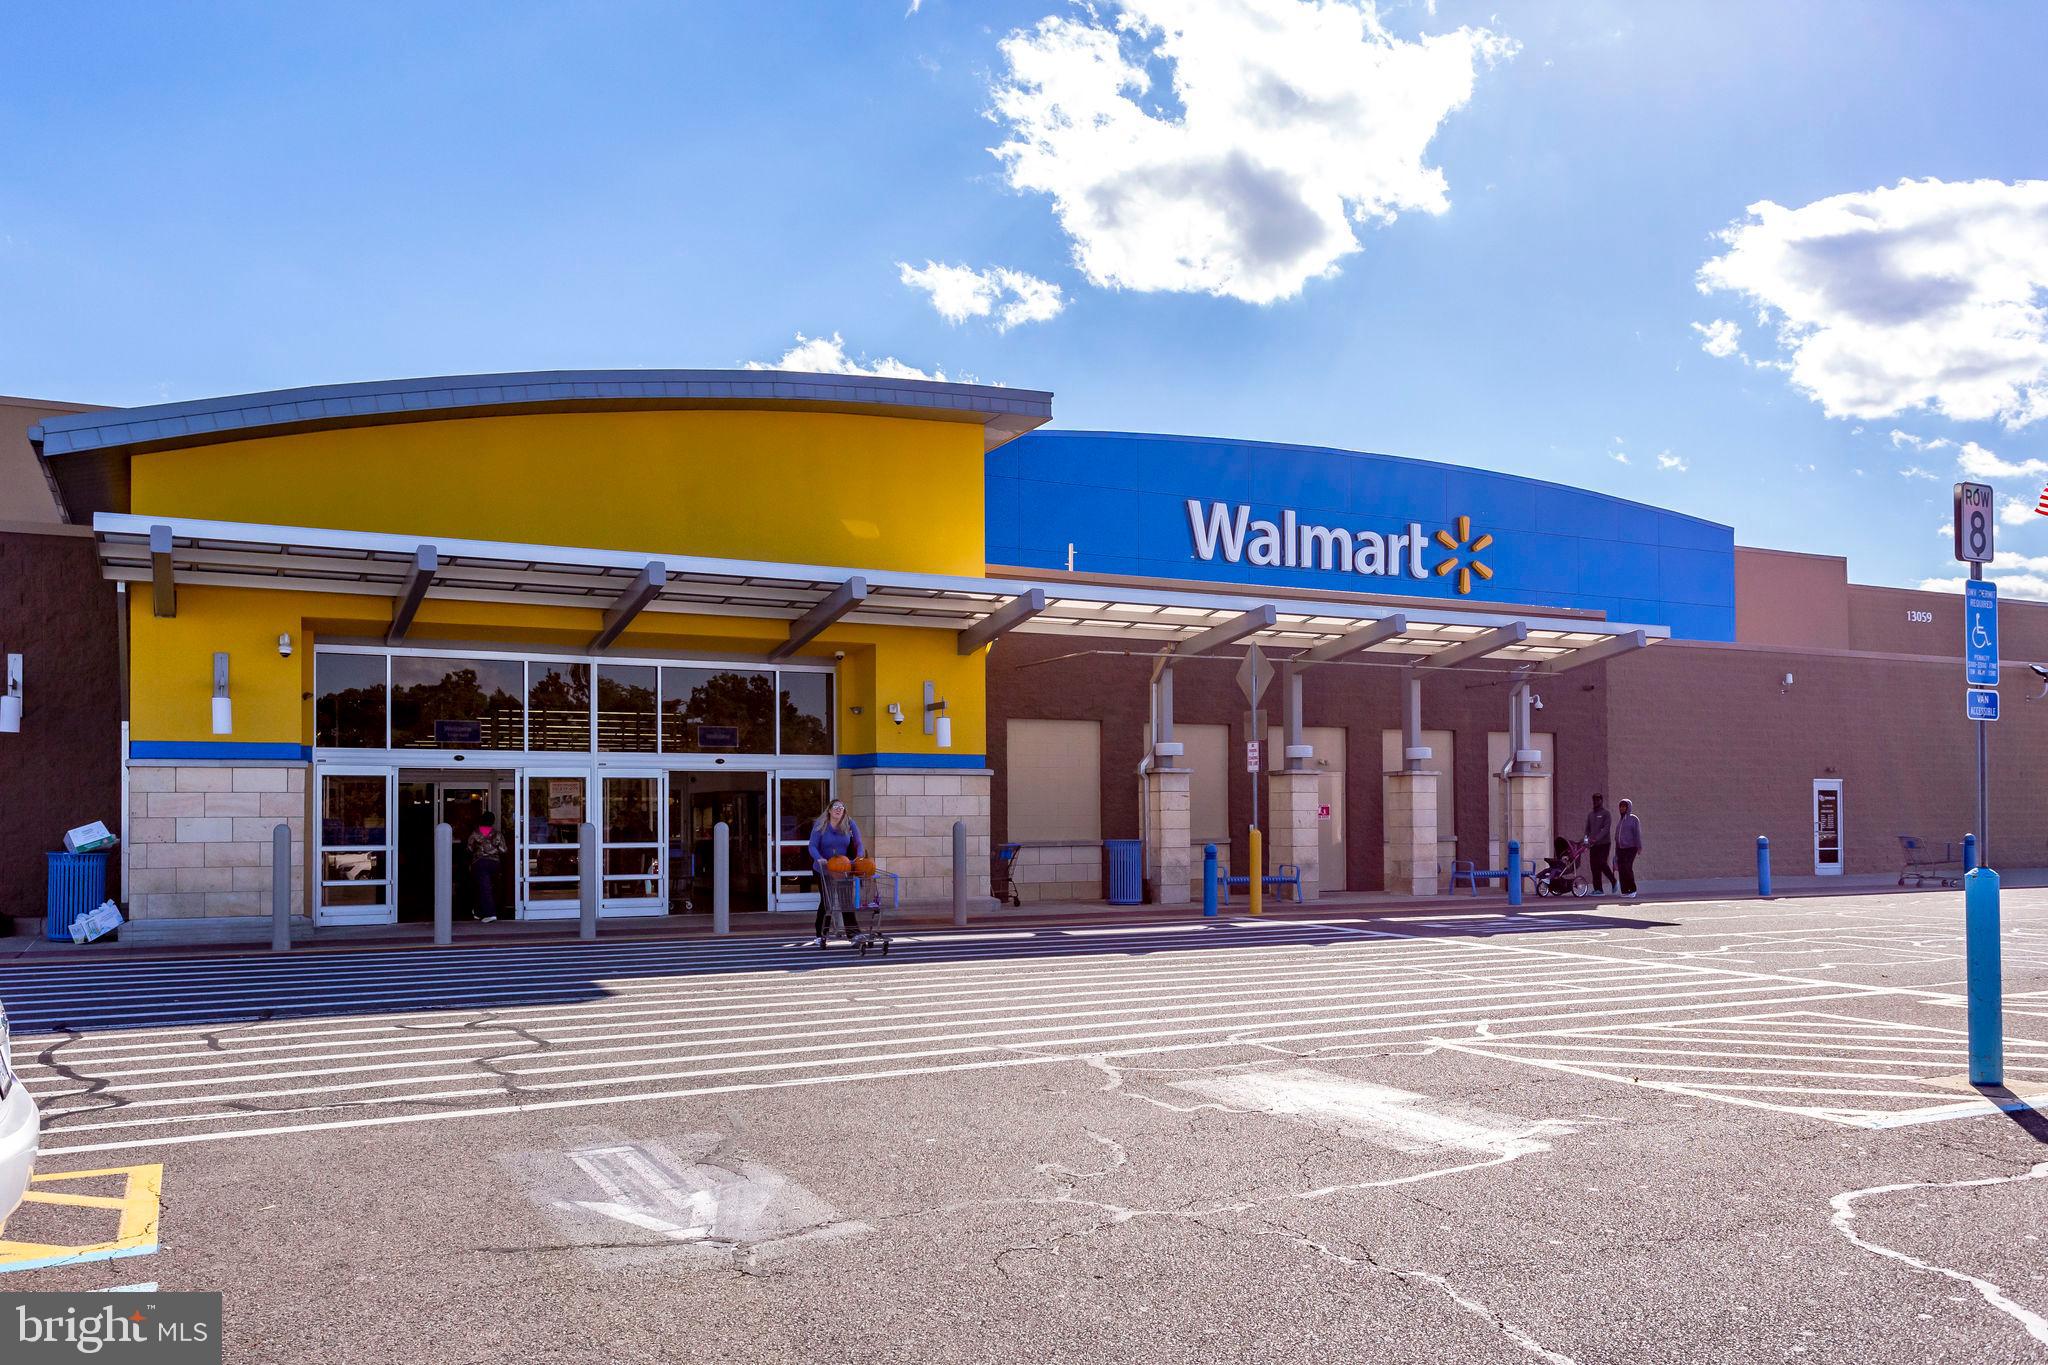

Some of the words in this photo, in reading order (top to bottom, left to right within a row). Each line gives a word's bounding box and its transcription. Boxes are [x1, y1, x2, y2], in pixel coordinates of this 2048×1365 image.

[1965, 488, 1990, 508] ROW
[1187, 499, 1429, 579] Walmart
[1969, 511, 1987, 555] 8
[1906, 610, 1932, 623] 13059
[1977, 695, 1989, 704] VAN
[1970, 706, 1997, 716] ACCESSIBLE
